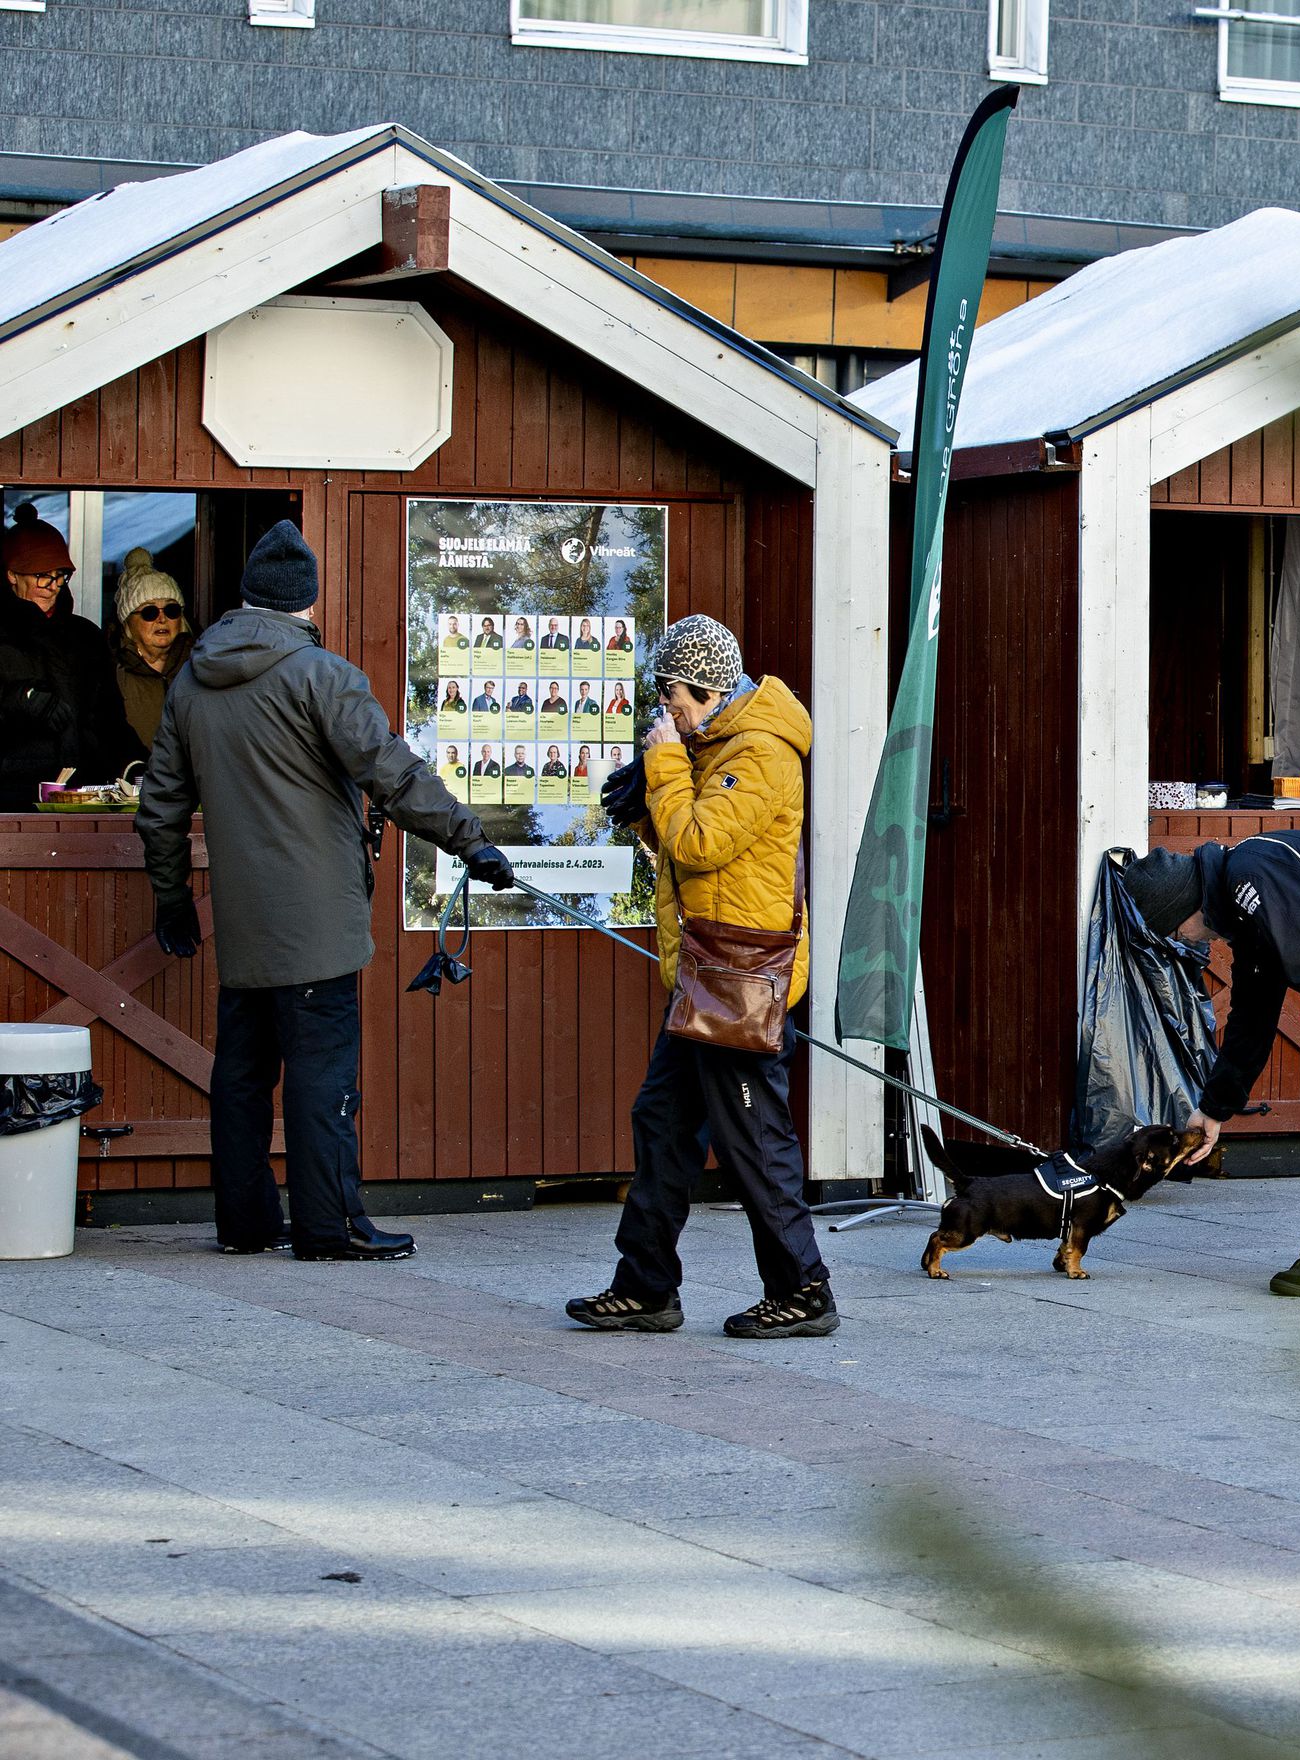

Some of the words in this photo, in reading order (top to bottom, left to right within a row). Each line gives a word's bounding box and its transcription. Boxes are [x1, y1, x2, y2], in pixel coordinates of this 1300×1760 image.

[485, 535, 535, 552] ELÄMÄÄ.
[589, 545, 636, 558] Vihreät
[438, 551, 494, 569] ÄÄNESTÄ.
[509, 859, 565, 869] untavaaleissa
[566, 859, 605, 869] 2.4.2023.
[741, 1082, 752, 1108] HALTI
[1061, 1174, 1092, 1186] SECURITY
